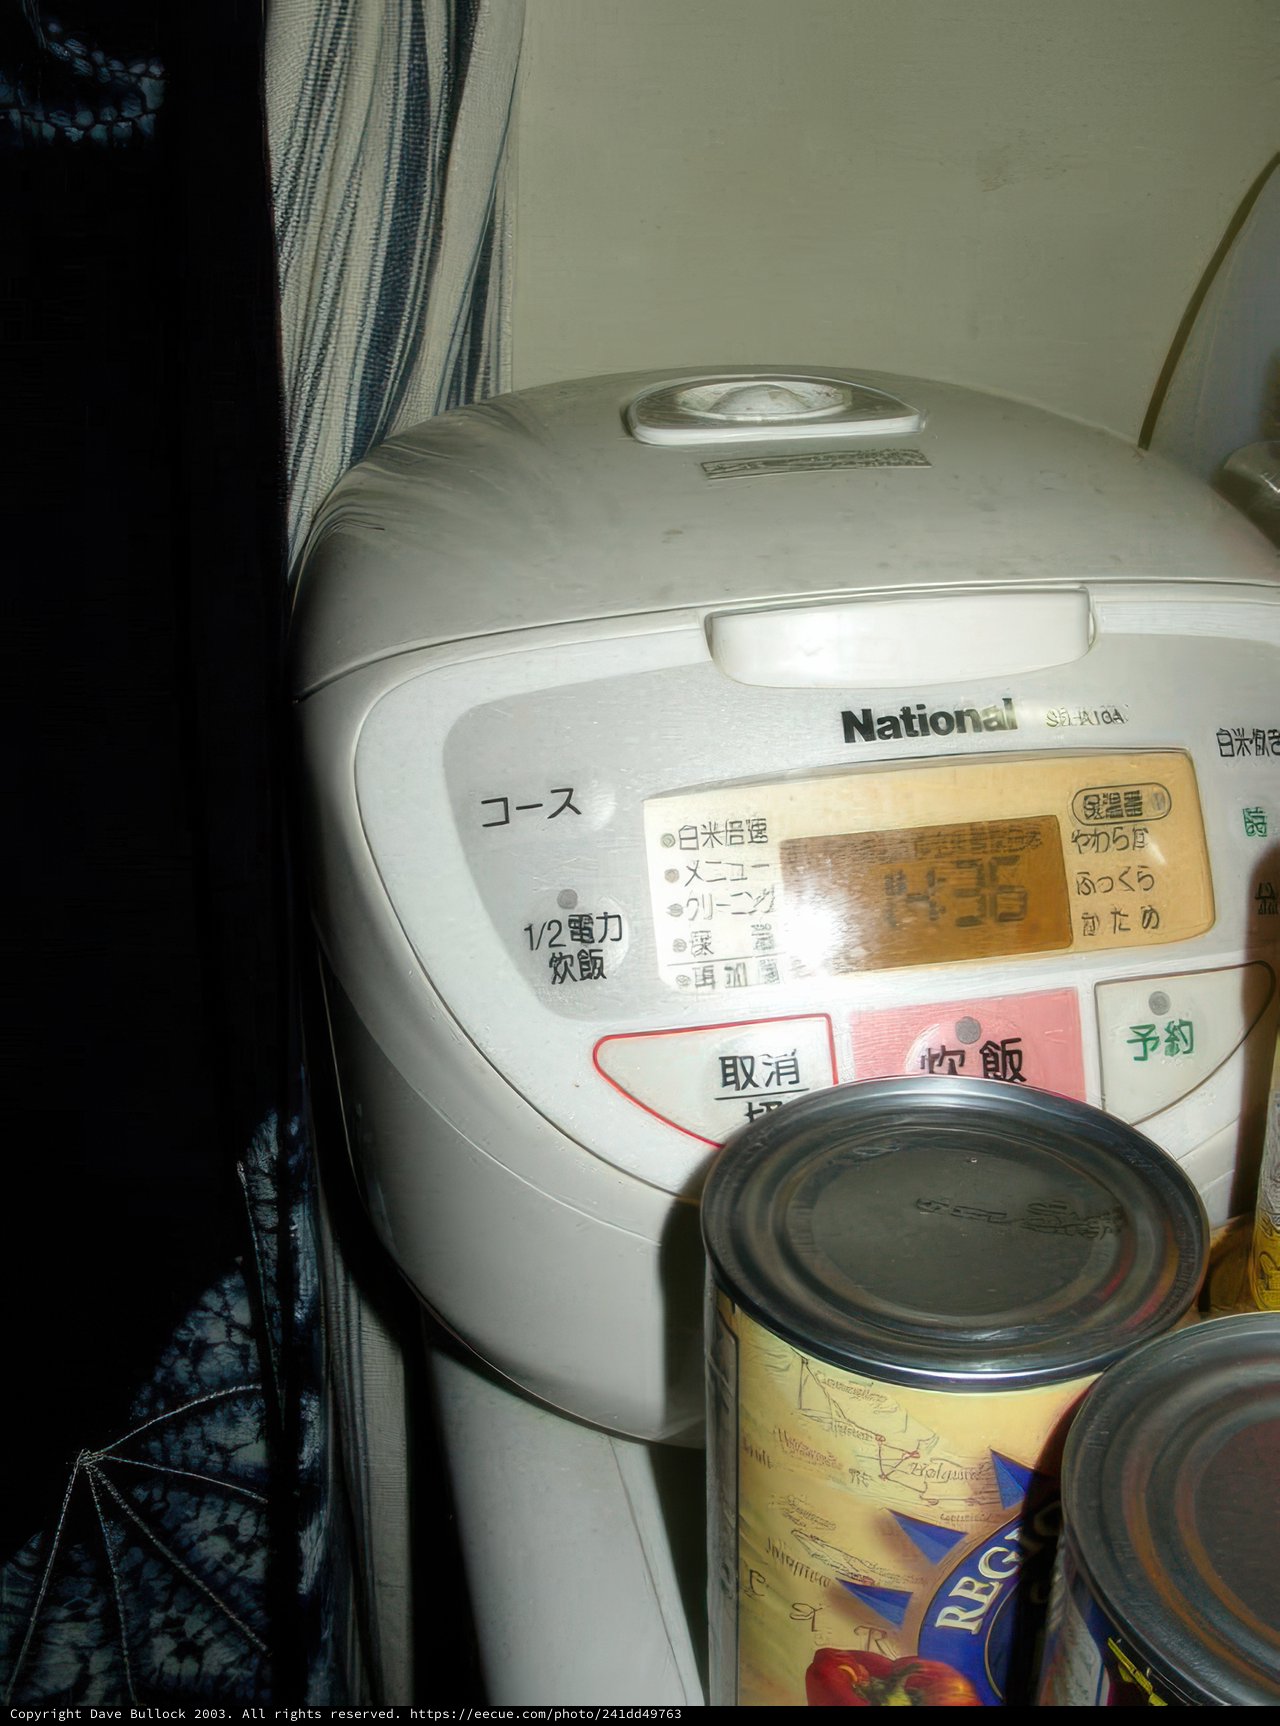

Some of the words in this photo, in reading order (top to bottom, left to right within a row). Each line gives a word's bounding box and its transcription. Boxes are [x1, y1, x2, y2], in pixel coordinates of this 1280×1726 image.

[841, 697, 1018, 743] National
[481, 787, 582, 828] コース
[524, 911, 623, 951] 1/2電力
[549, 948, 607, 985] 炊飯
[1126, 1019, 1196, 1062] 予約
[718, 1048, 801, 1091] 取消
